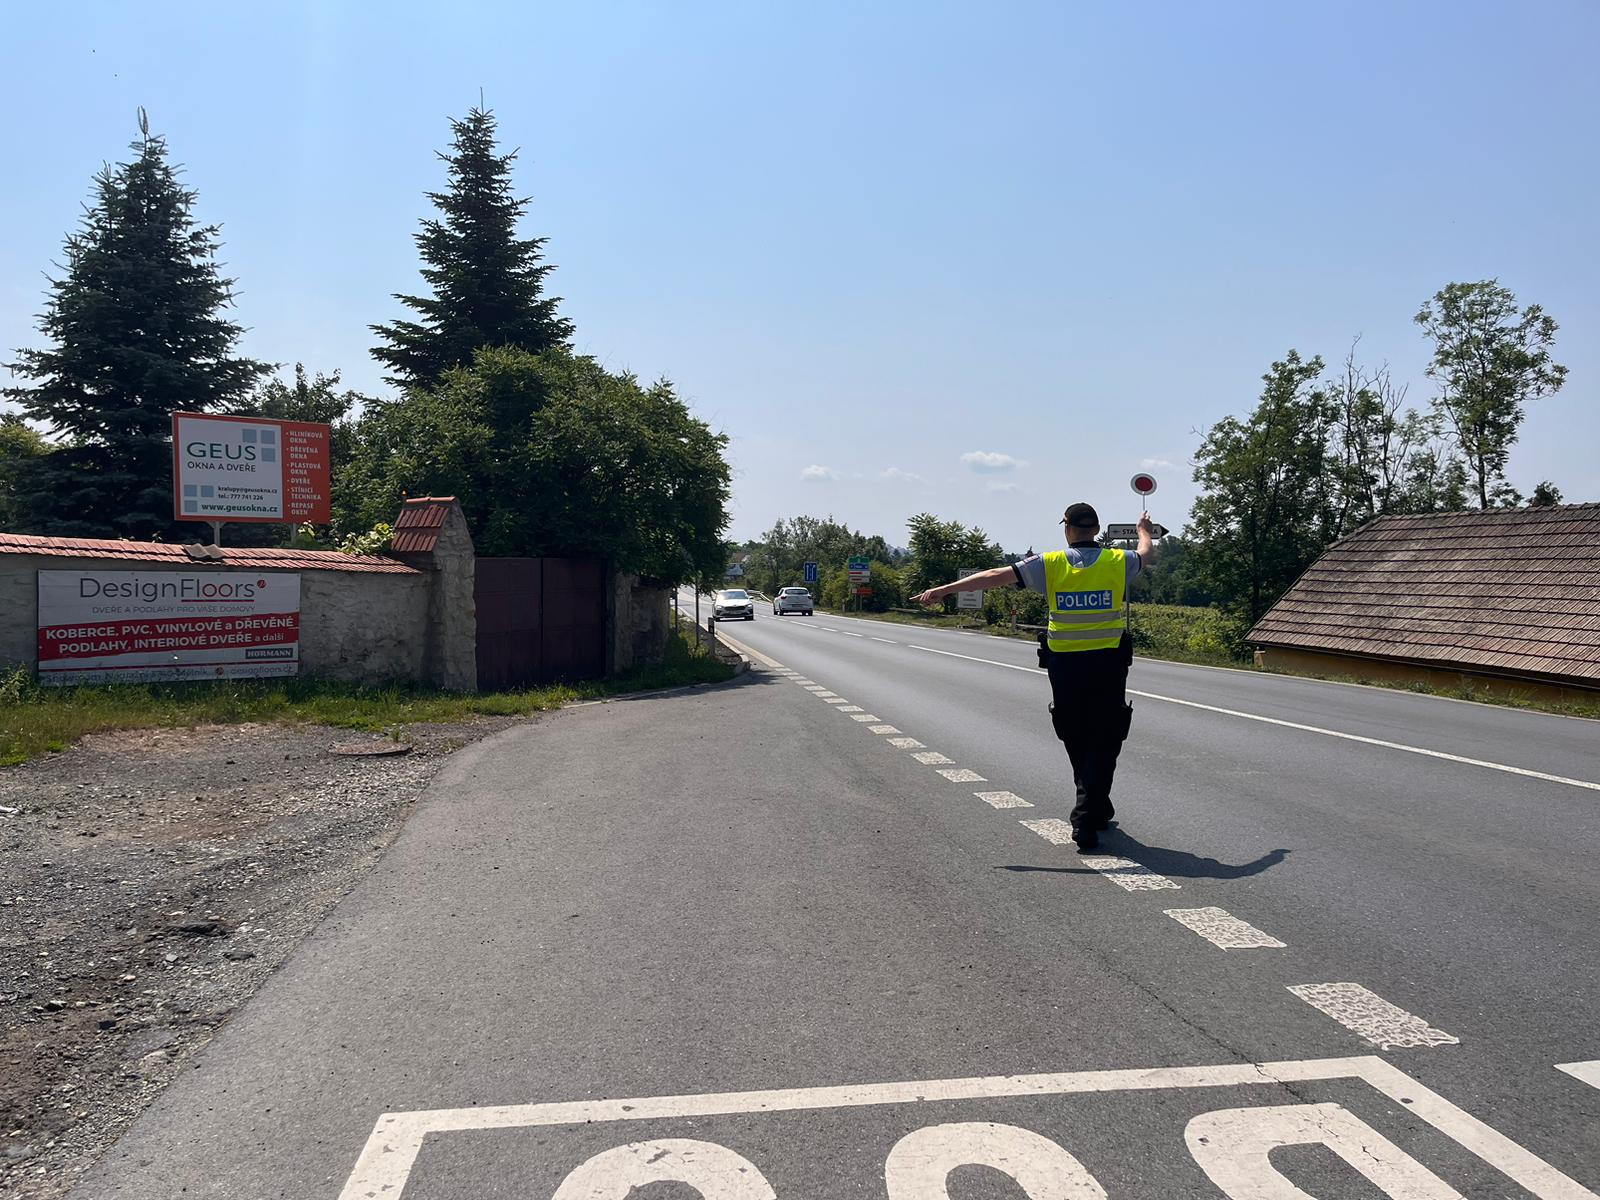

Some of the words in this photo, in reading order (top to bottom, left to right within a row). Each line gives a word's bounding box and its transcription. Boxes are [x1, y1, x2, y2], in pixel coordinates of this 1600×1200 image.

[186, 442, 256, 461] GEUS
[187, 461, 215, 470] OKNA
[226, 463, 256, 472] DVEŘE
[217, 485, 278, 494] kralupy@geusokna.cz
[201, 503, 278, 513] www.geusokna.cz
[80, 578, 255, 602] DesignFloors
[1057, 592, 1110, 607] POLICIE
[92, 606, 122, 614] DVEŘE
[196, 604, 217, 612] VAŠE
[46, 627, 119, 639] KOBERCE,
[122, 625, 153, 636] PVC,
[155, 619, 222, 634] VINYLOVÉ
[235, 617, 294, 630] DŘEVĚNÉ
[58, 640, 131, 654] PODLAHY,
[134, 634, 207, 649] INTERIOVÉ
[209, 632, 252, 644] DVEŘE
[262, 633, 285, 642] další
